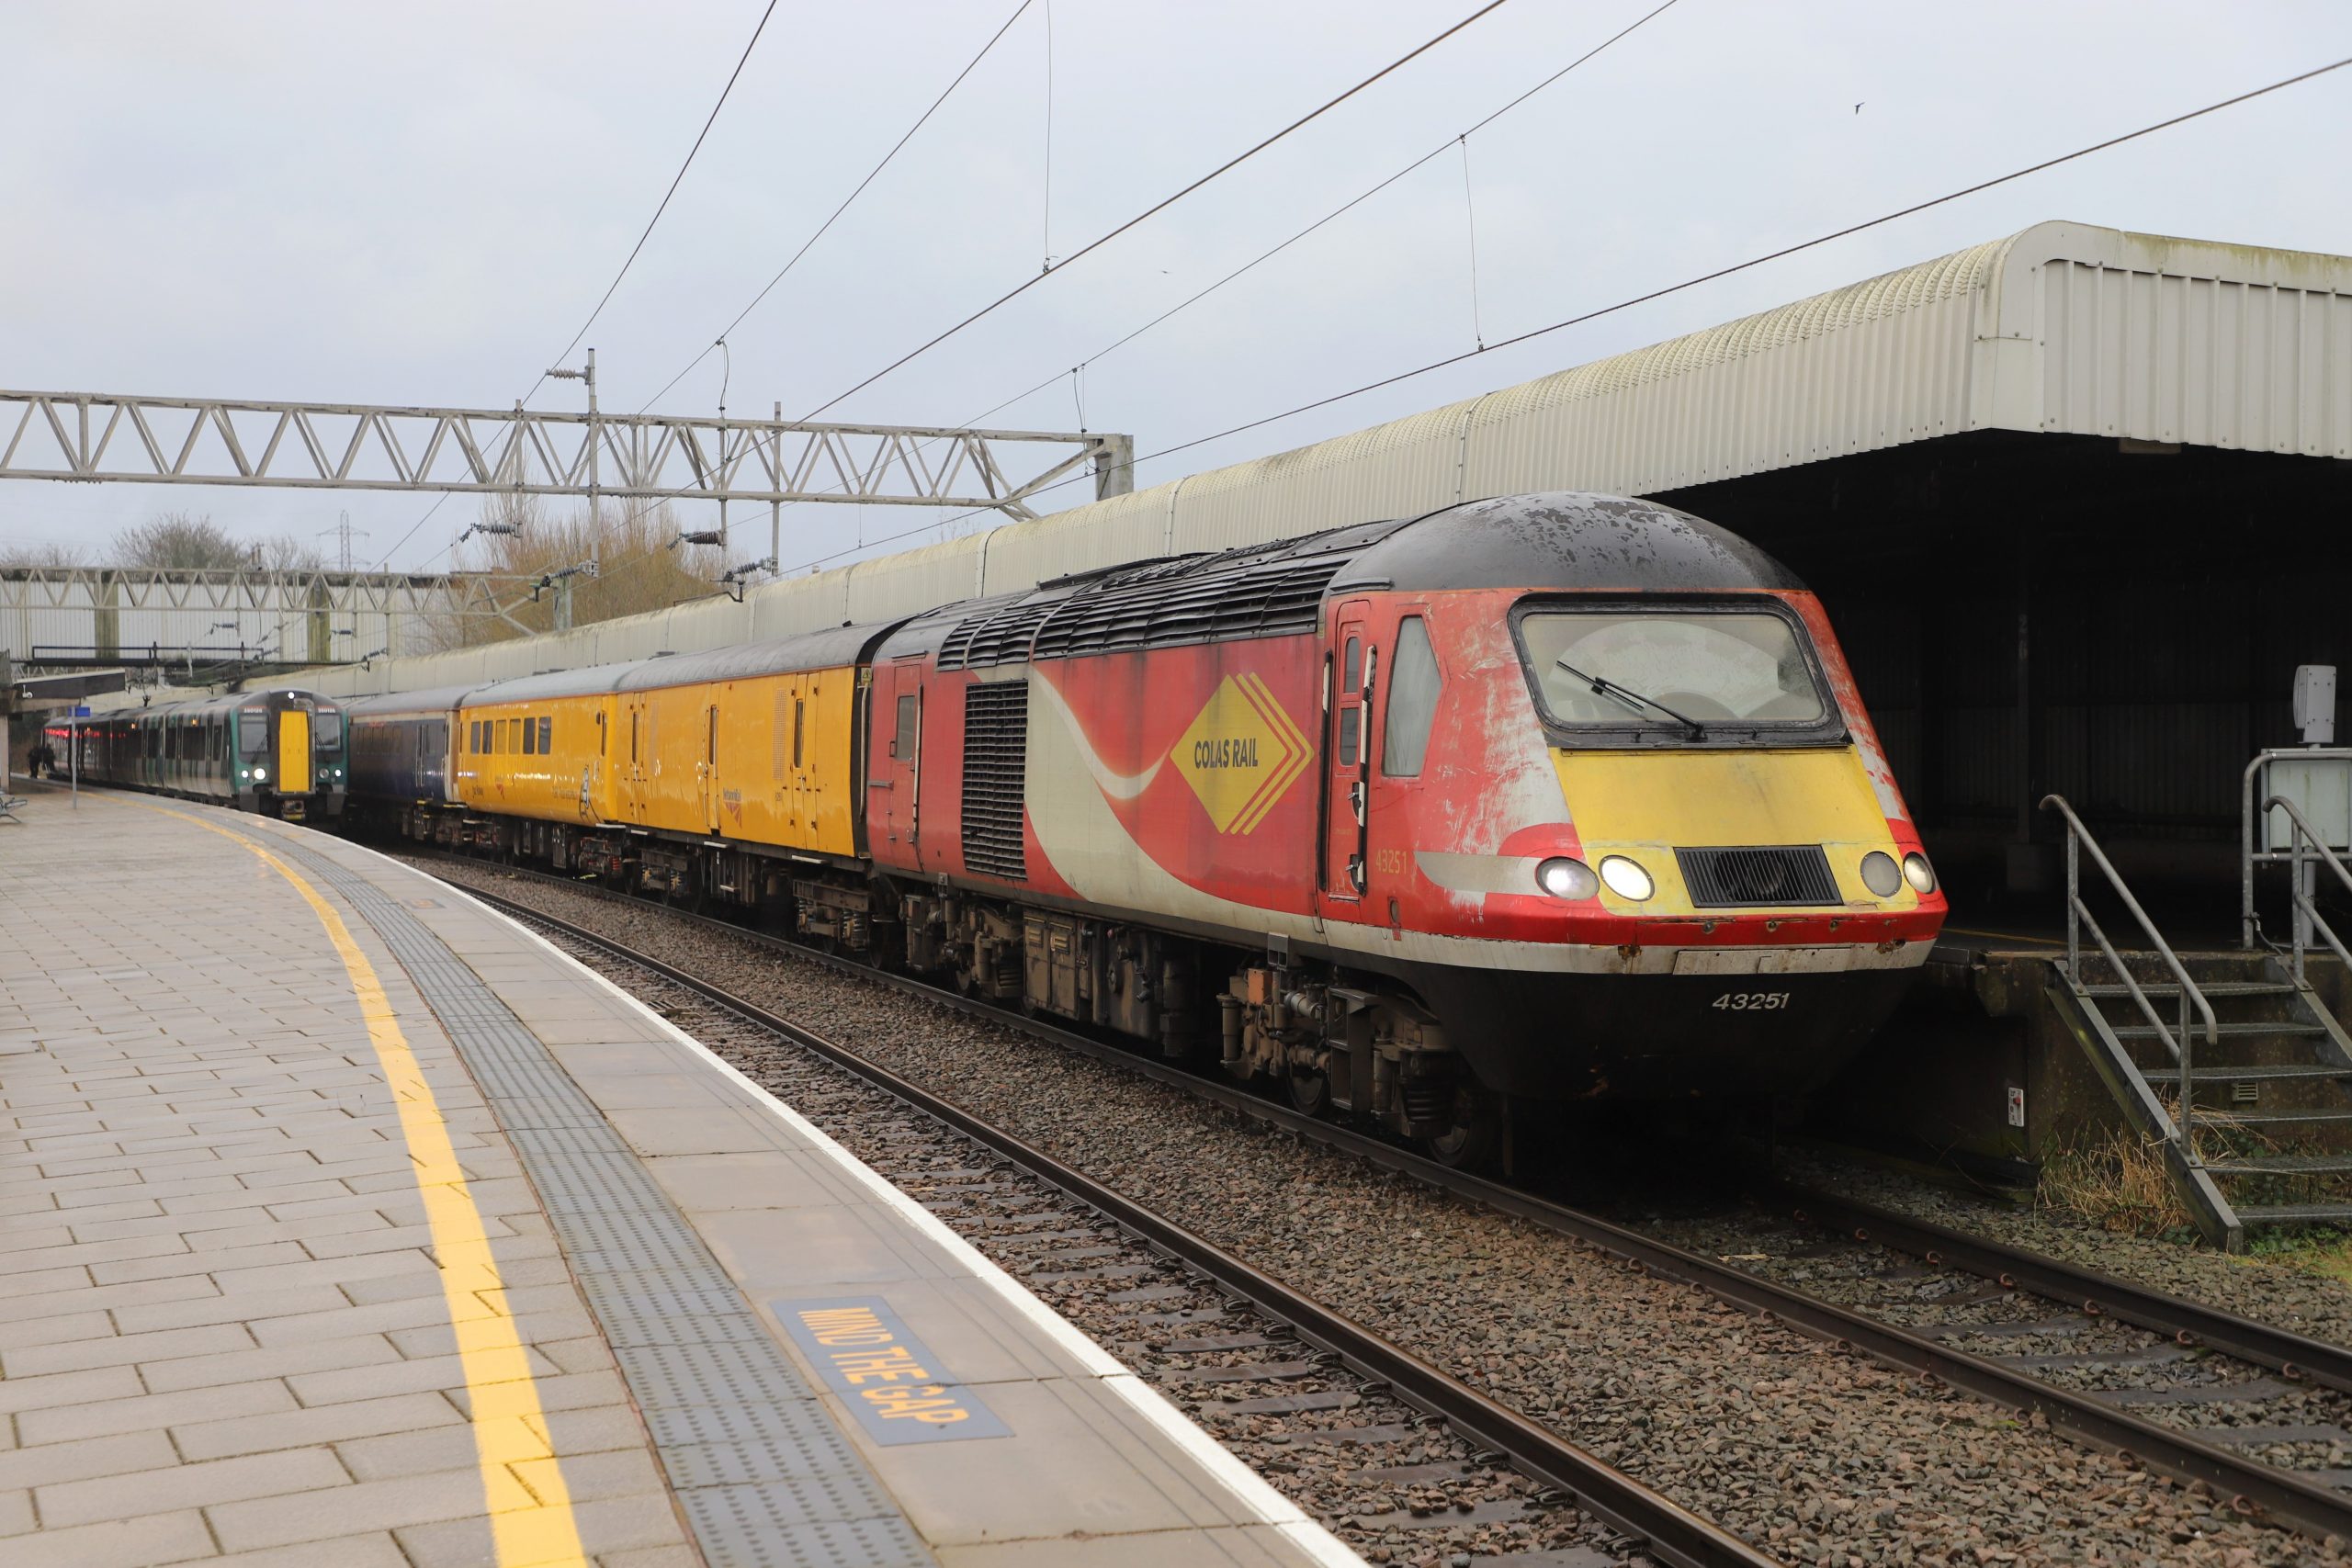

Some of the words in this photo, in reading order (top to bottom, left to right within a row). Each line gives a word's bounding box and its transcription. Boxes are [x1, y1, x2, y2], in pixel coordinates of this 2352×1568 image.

[1194, 739, 1229, 769] COLAS
[1232, 738, 1258, 767] RAIL
[1376, 849, 1408, 875] 43251
[1712, 993, 1790, 1010] 43251
[797, 1307, 893, 1346] MIND
[831, 1346, 930, 1384] THE
[861, 1385, 969, 1423] GAP
